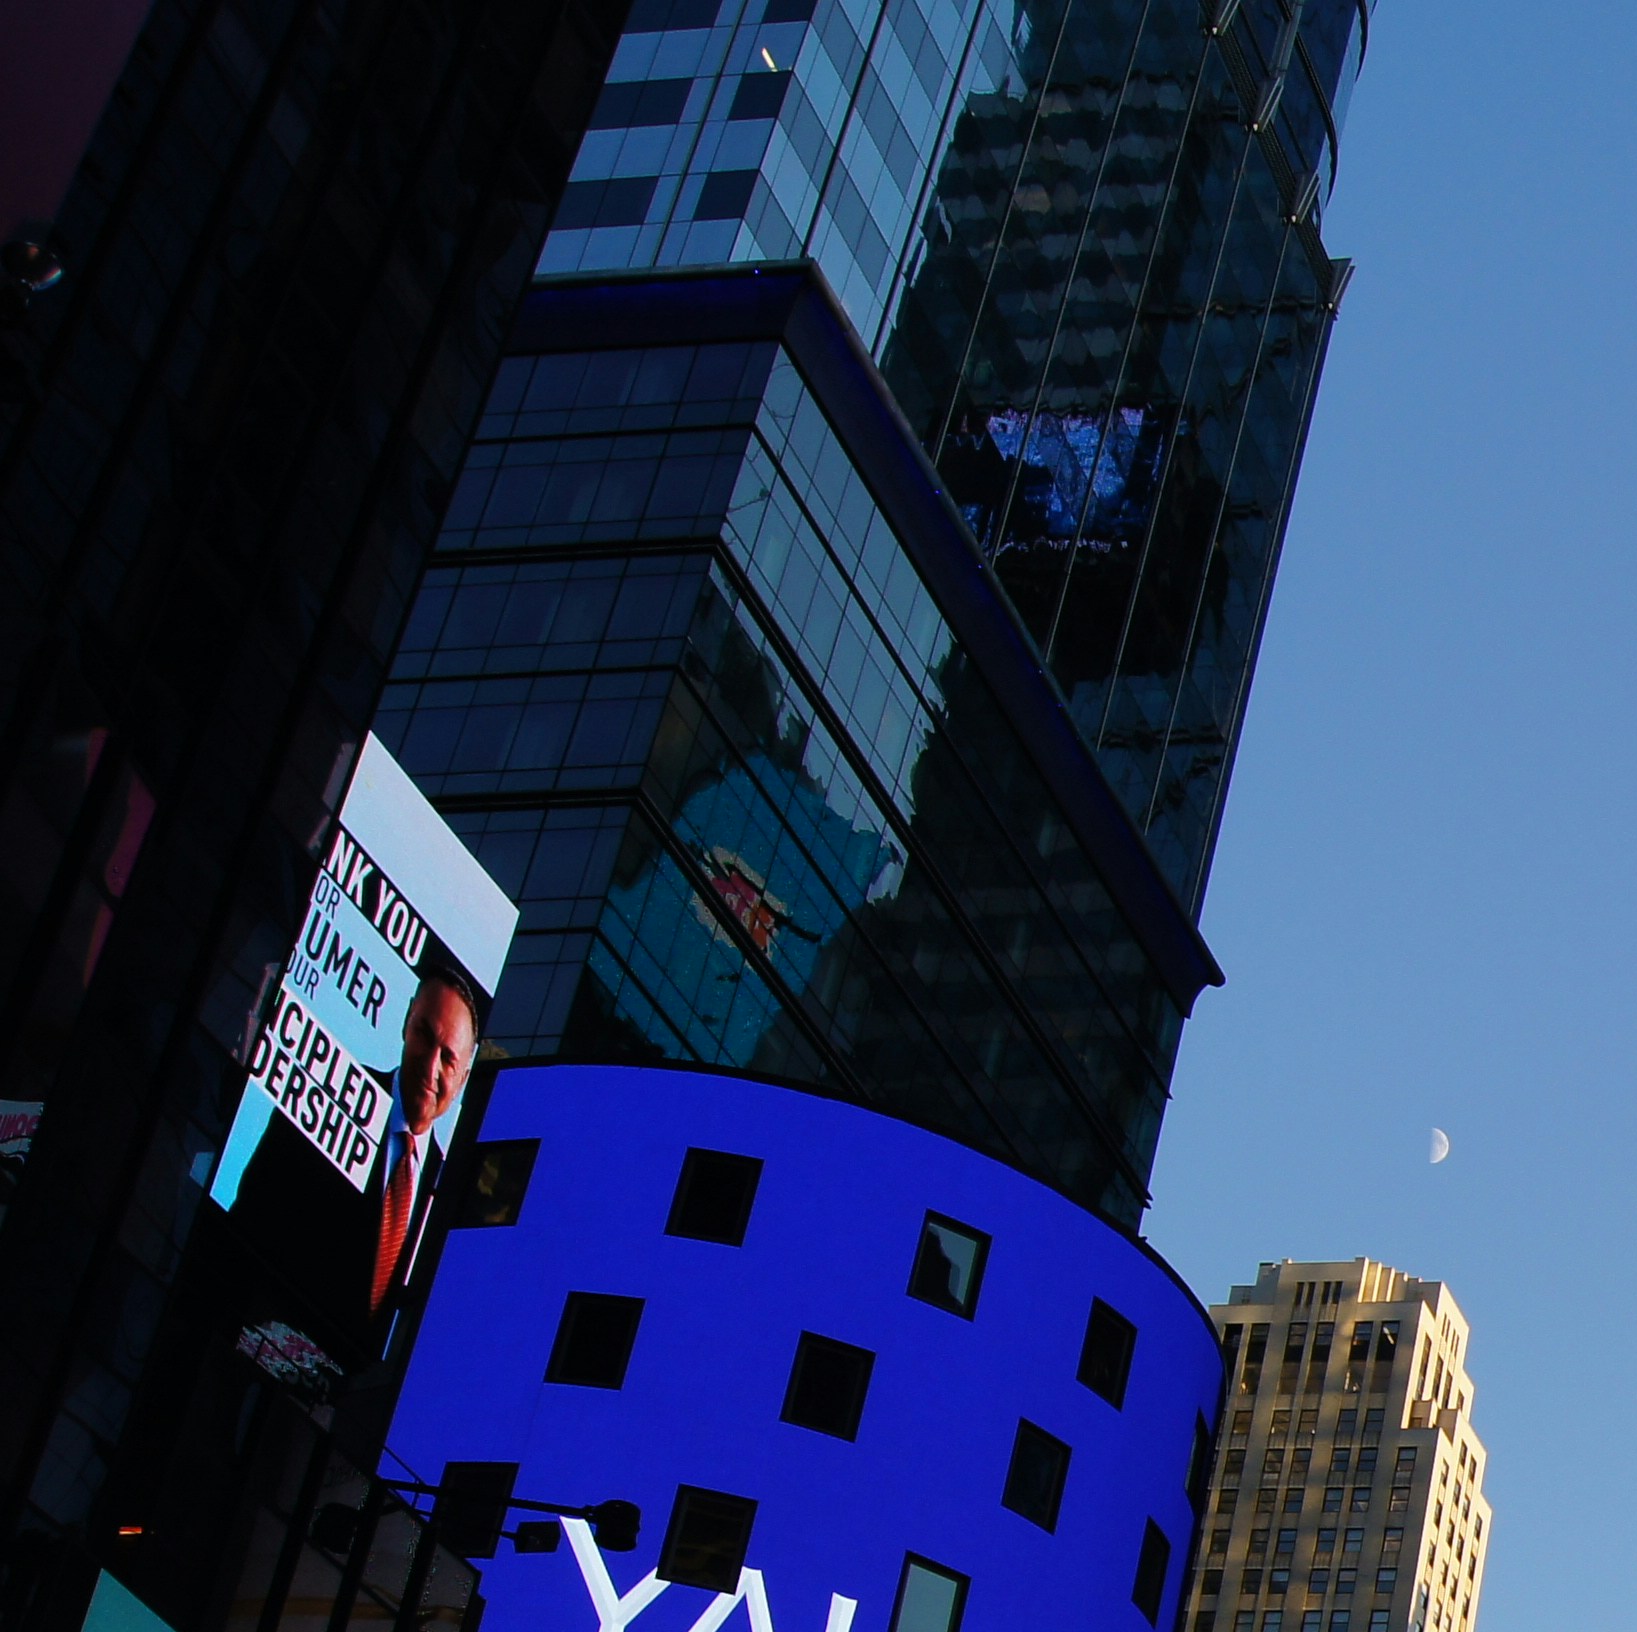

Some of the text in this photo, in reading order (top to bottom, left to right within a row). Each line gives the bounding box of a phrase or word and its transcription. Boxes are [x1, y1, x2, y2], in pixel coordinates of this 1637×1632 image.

[315, 874, 341, 920] OR
[371, 878, 428, 967] YOU
[305, 909, 387, 1030] UMER
